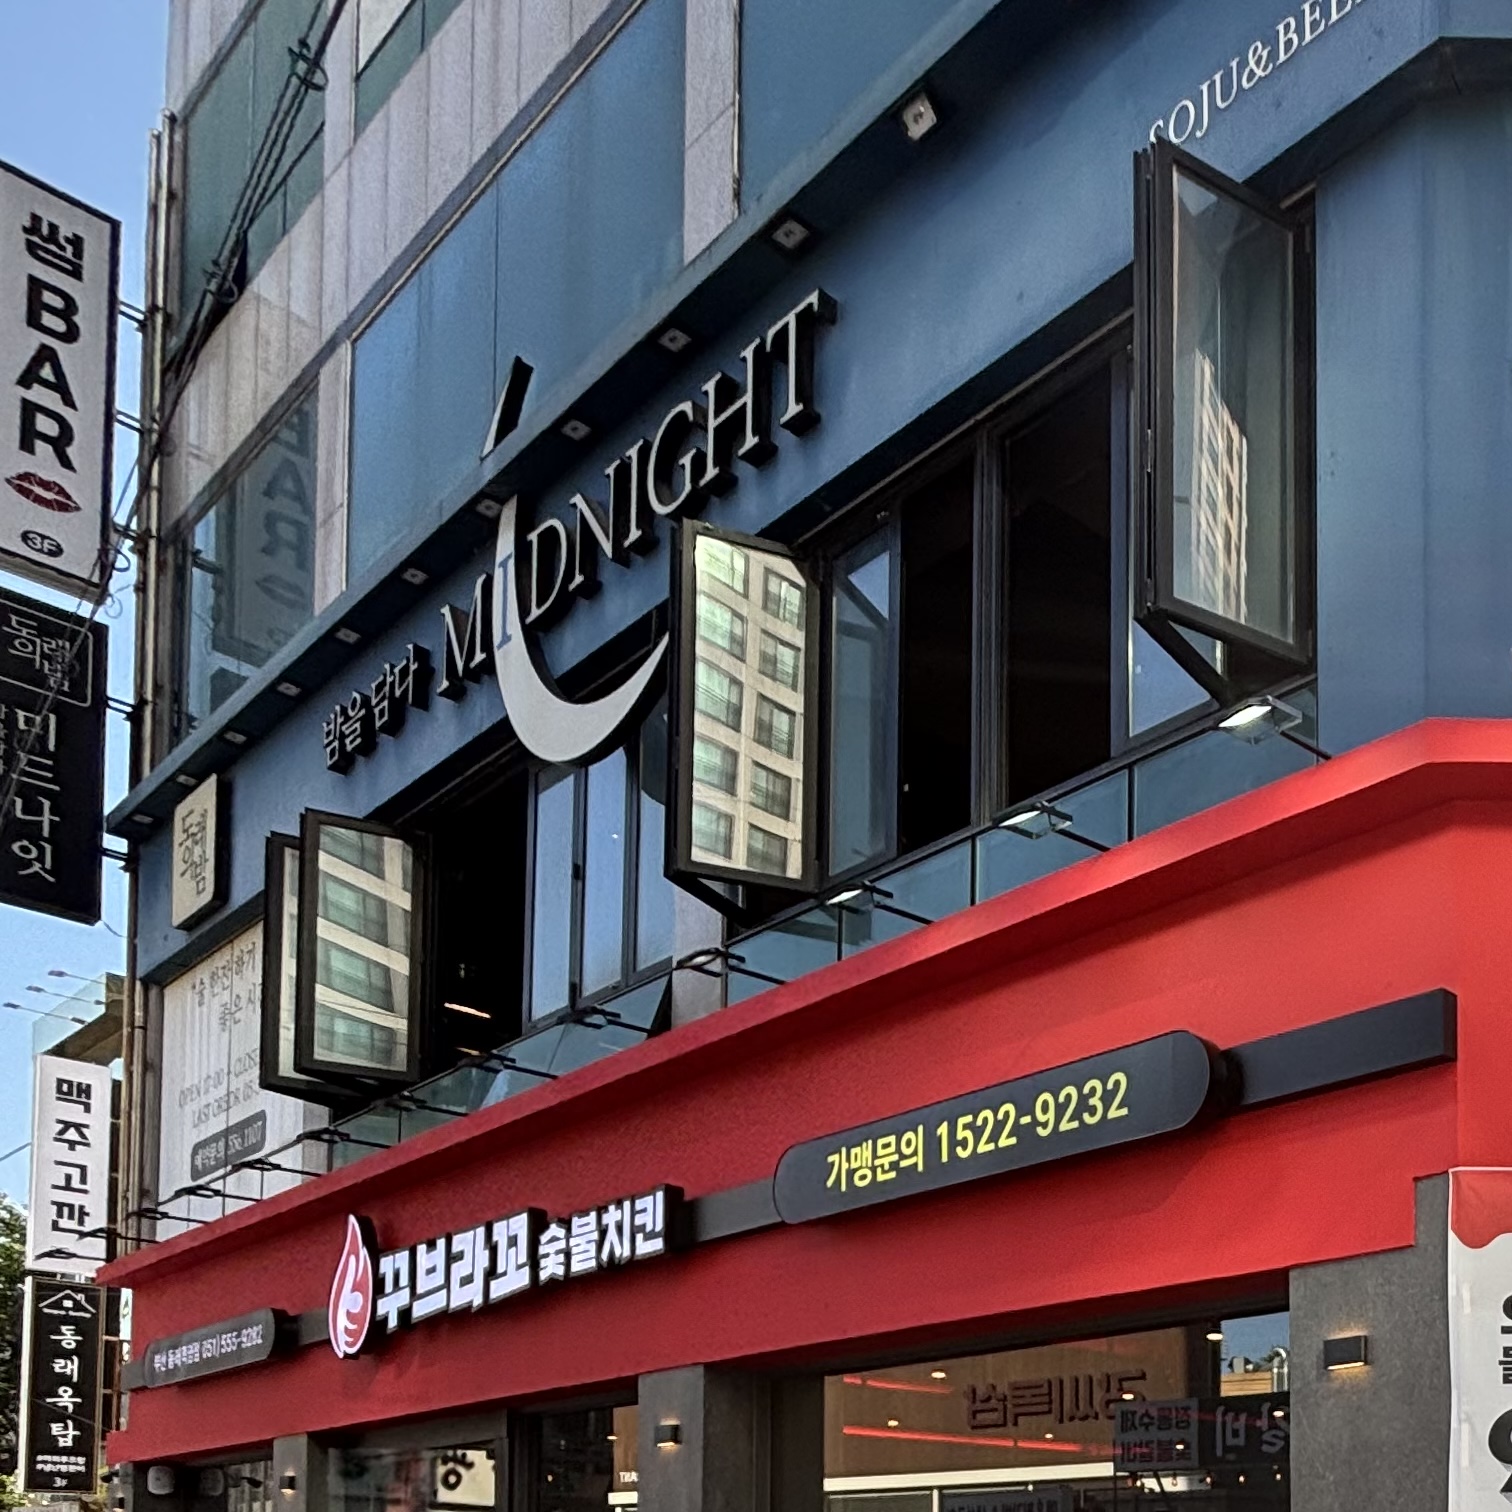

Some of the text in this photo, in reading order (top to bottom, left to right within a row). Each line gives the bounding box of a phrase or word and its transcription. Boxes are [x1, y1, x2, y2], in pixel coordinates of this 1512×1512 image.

[27, 532, 58, 555] 3F
[436, 288, 836, 696] MIDNIGHT
[825, 1071, 1130, 1192] 가맹문의 1522-9232
[376, 1189, 665, 1334] 꾸브라꼬 숯불치킨
[45, 1326, 83, 1448] 동래옥탑
